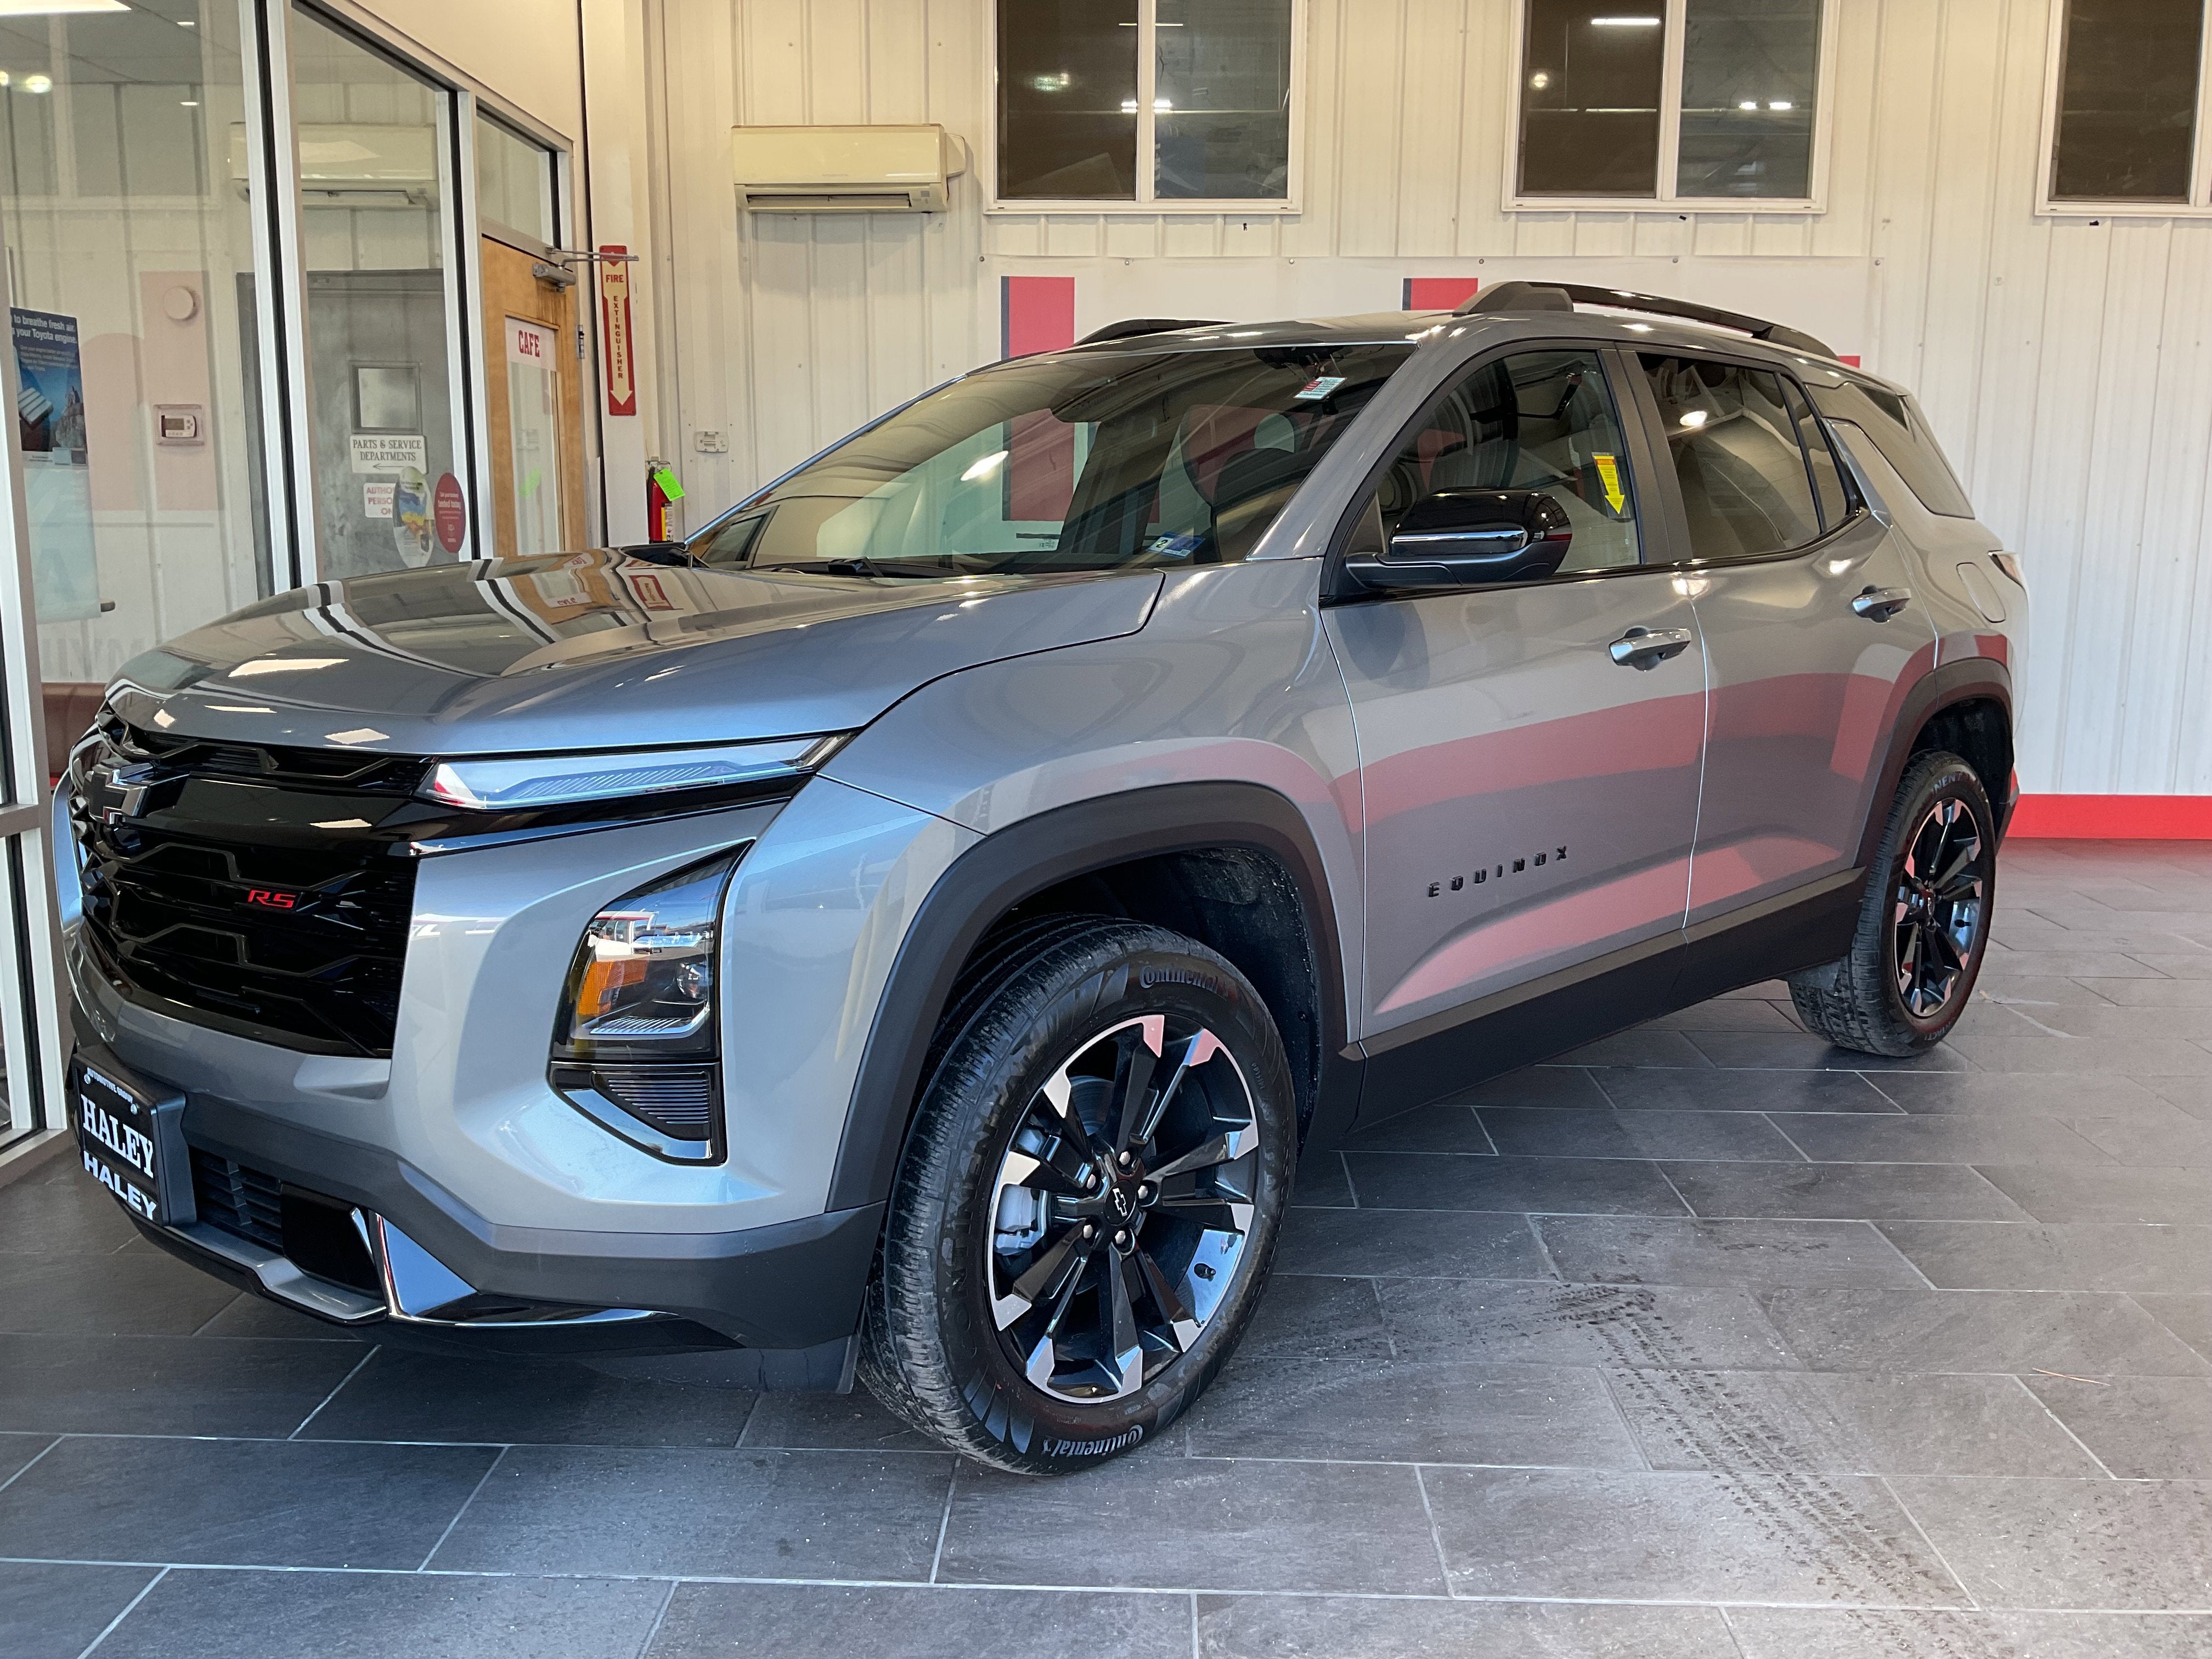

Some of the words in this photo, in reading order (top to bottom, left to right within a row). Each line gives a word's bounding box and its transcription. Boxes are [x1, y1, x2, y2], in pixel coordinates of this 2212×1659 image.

[606, 274, 624, 283] FIRE
[14, 314, 21, 324] to
[22, 315, 48, 328] breathe
[48, 319, 65, 331] fresh
[16, 328, 31, 338] your
[32, 327, 54, 341] Toyota
[518, 330, 540, 358] CAFE
[613, 296, 623, 379] EXTINGUISHER
[353, 439, 377, 449] PARTS
[380, 440, 386, 449] &
[388, 440, 422, 449] SERVICE
[360, 452, 416, 461] DEPARTMENTS
[1428, 845, 1567, 898] EQUINOX
[248, 890, 296, 908] RS
[1139, 965, 1219, 995] Continental
[81, 1093, 154, 1178] HALEY
[83, 1150, 157, 1221] HALEY
[1050, 1424, 1144, 1458] Continental
